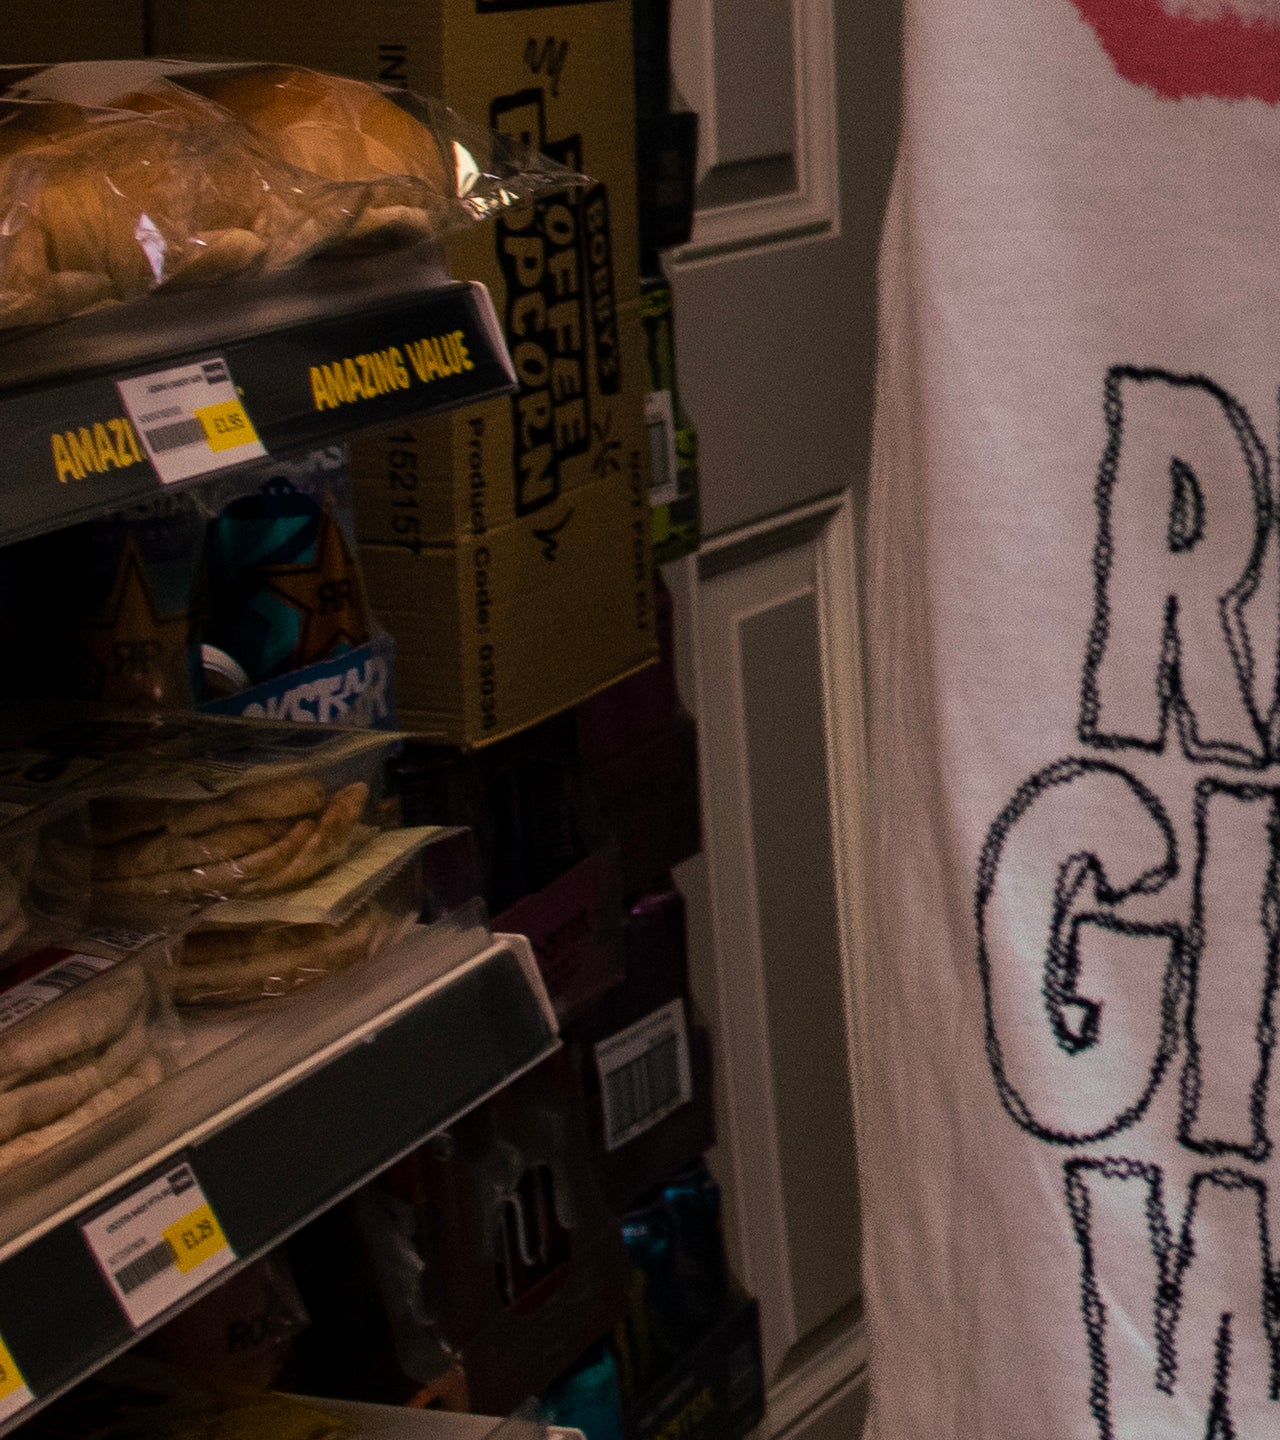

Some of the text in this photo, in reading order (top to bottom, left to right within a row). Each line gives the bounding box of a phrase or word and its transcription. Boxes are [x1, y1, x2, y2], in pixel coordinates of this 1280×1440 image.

[310, 330, 475, 412] AMAZING VALUE
[51, 417, 144, 485] AMAZI
[468, 416, 486, 536] Product
